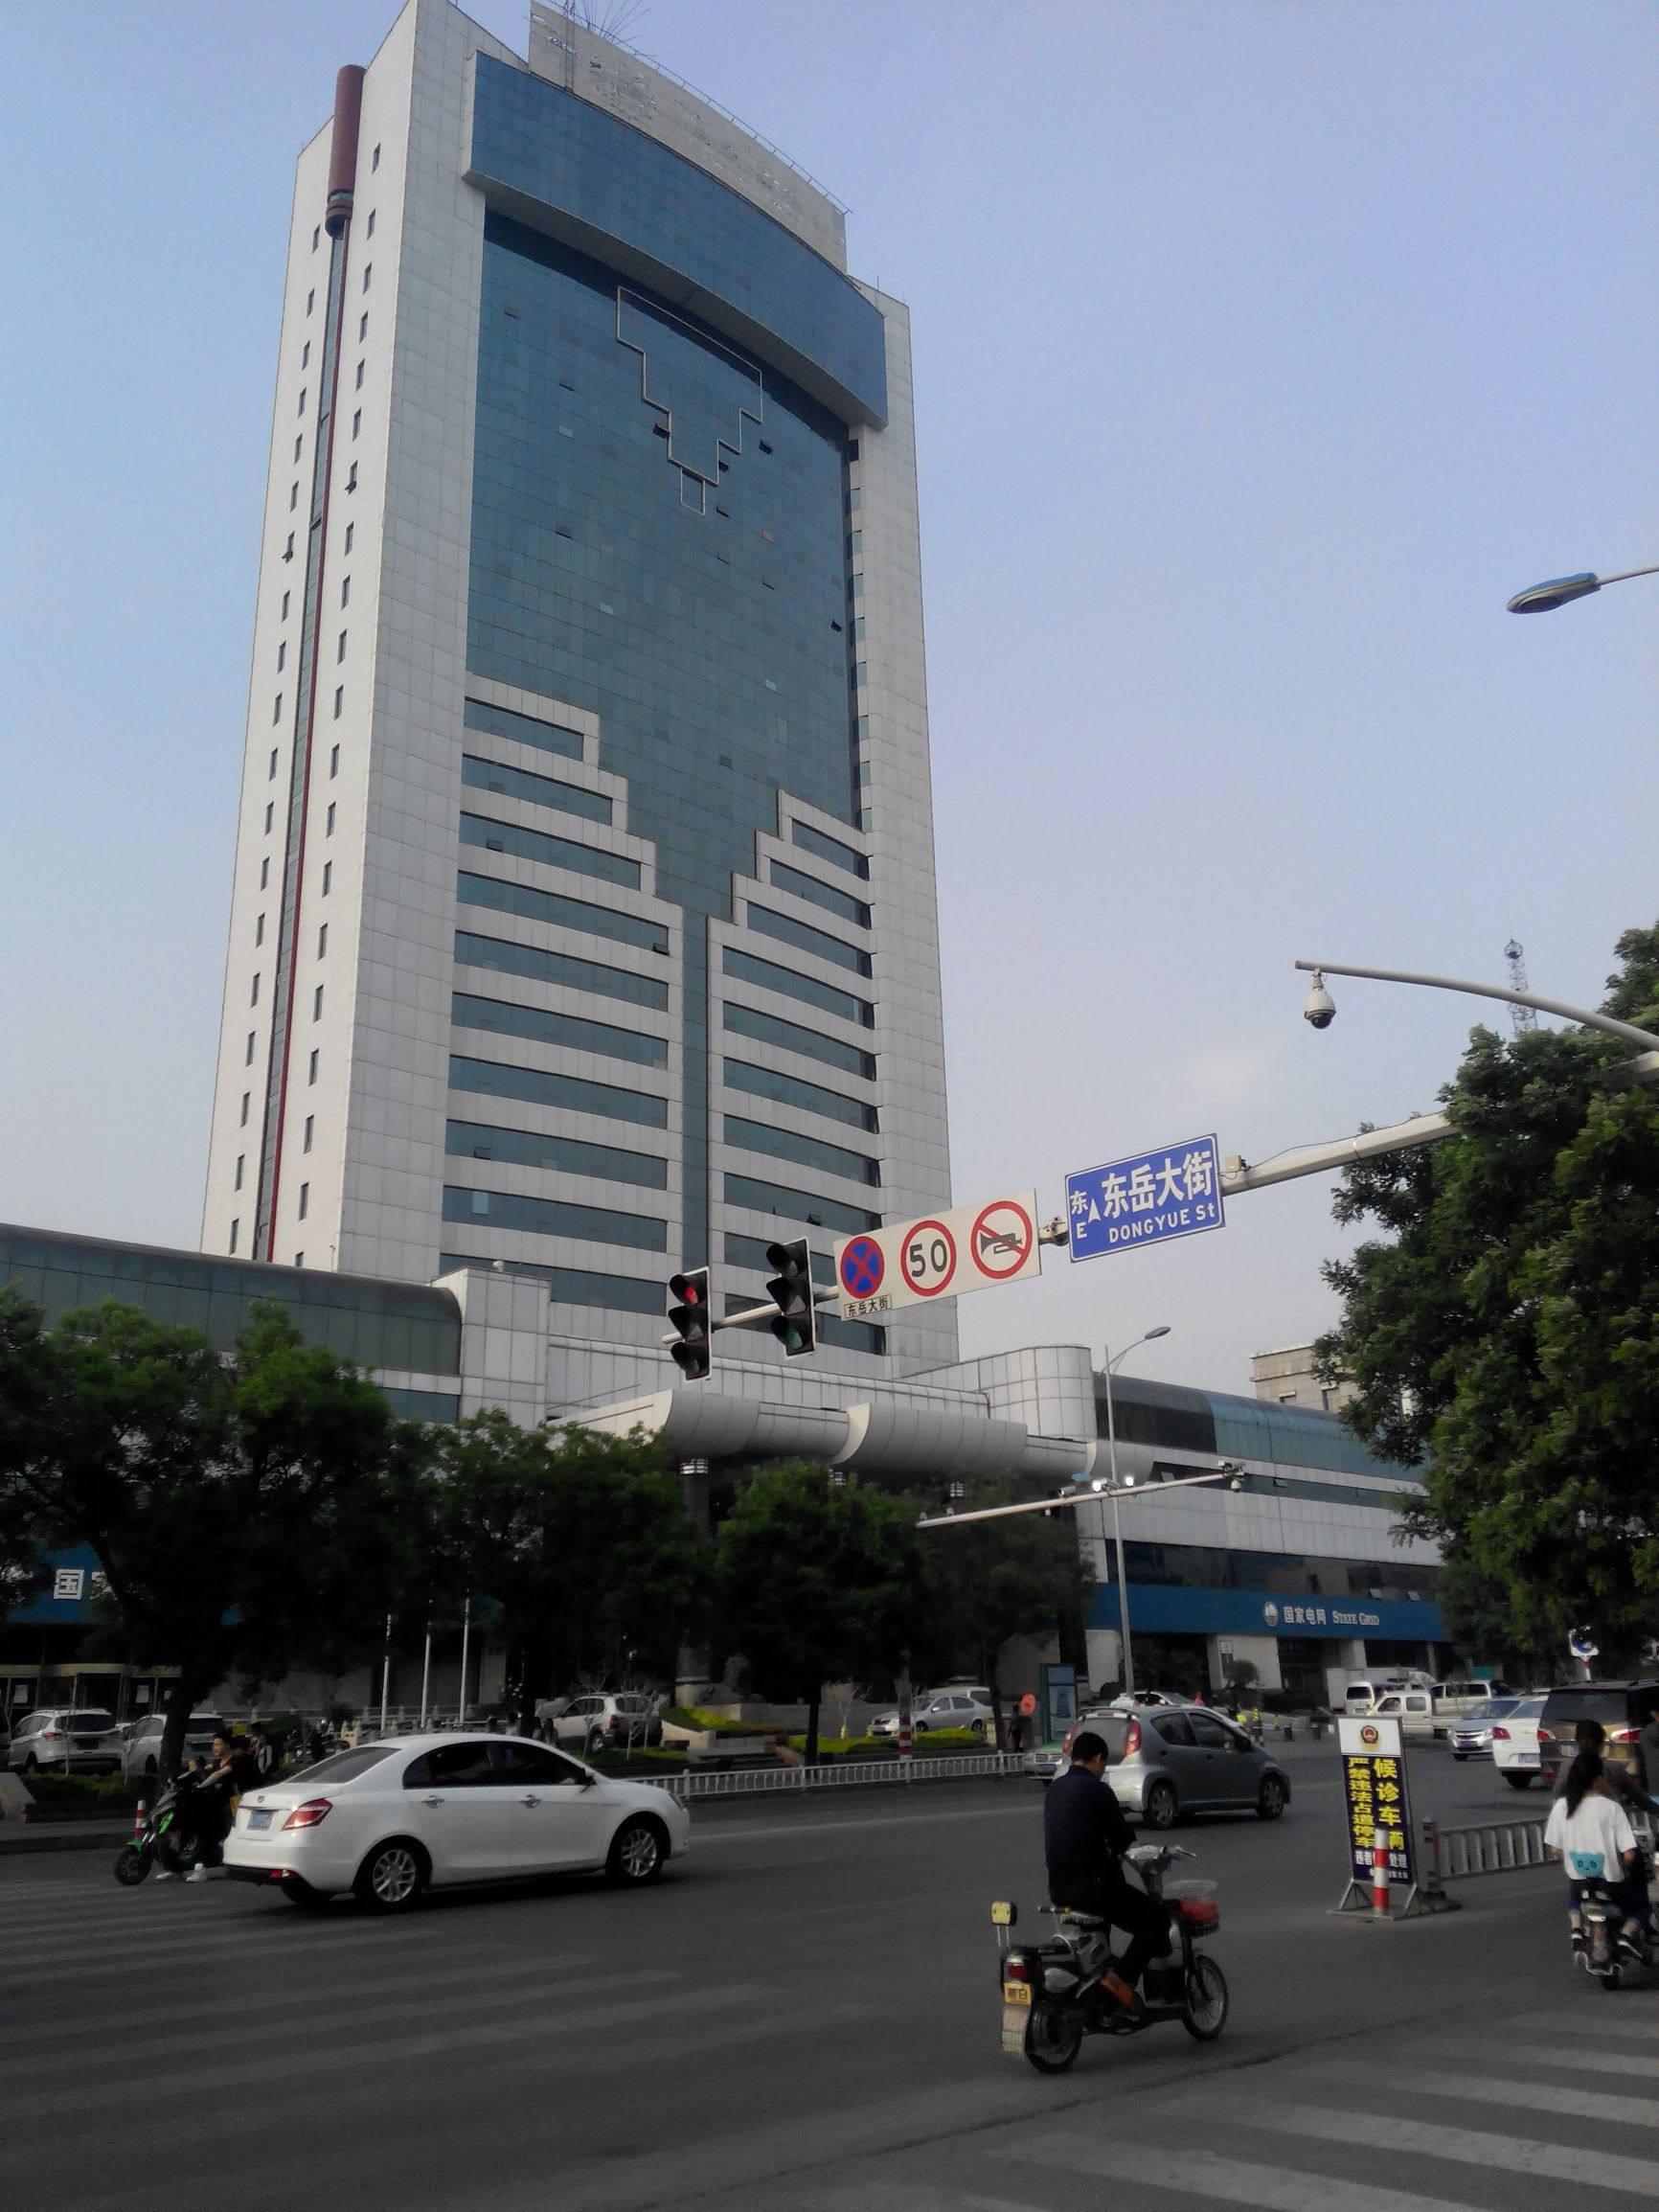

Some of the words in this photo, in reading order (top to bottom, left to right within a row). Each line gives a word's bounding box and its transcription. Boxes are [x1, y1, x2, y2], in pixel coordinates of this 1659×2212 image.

[1102, 1151, 1213, 1219] 东岳大街
[1070, 1191, 1088, 1215] 东
[1076, 1222, 1088, 1239] E
[1109, 1208, 1191, 1243] DONGYUE
[1195, 1202, 1216, 1221] St
[909, 1239, 948, 1278] 50
[848, 1296, 889, 1317] 东岳大街
[1283, 1607, 1327, 1626] 国家电网
